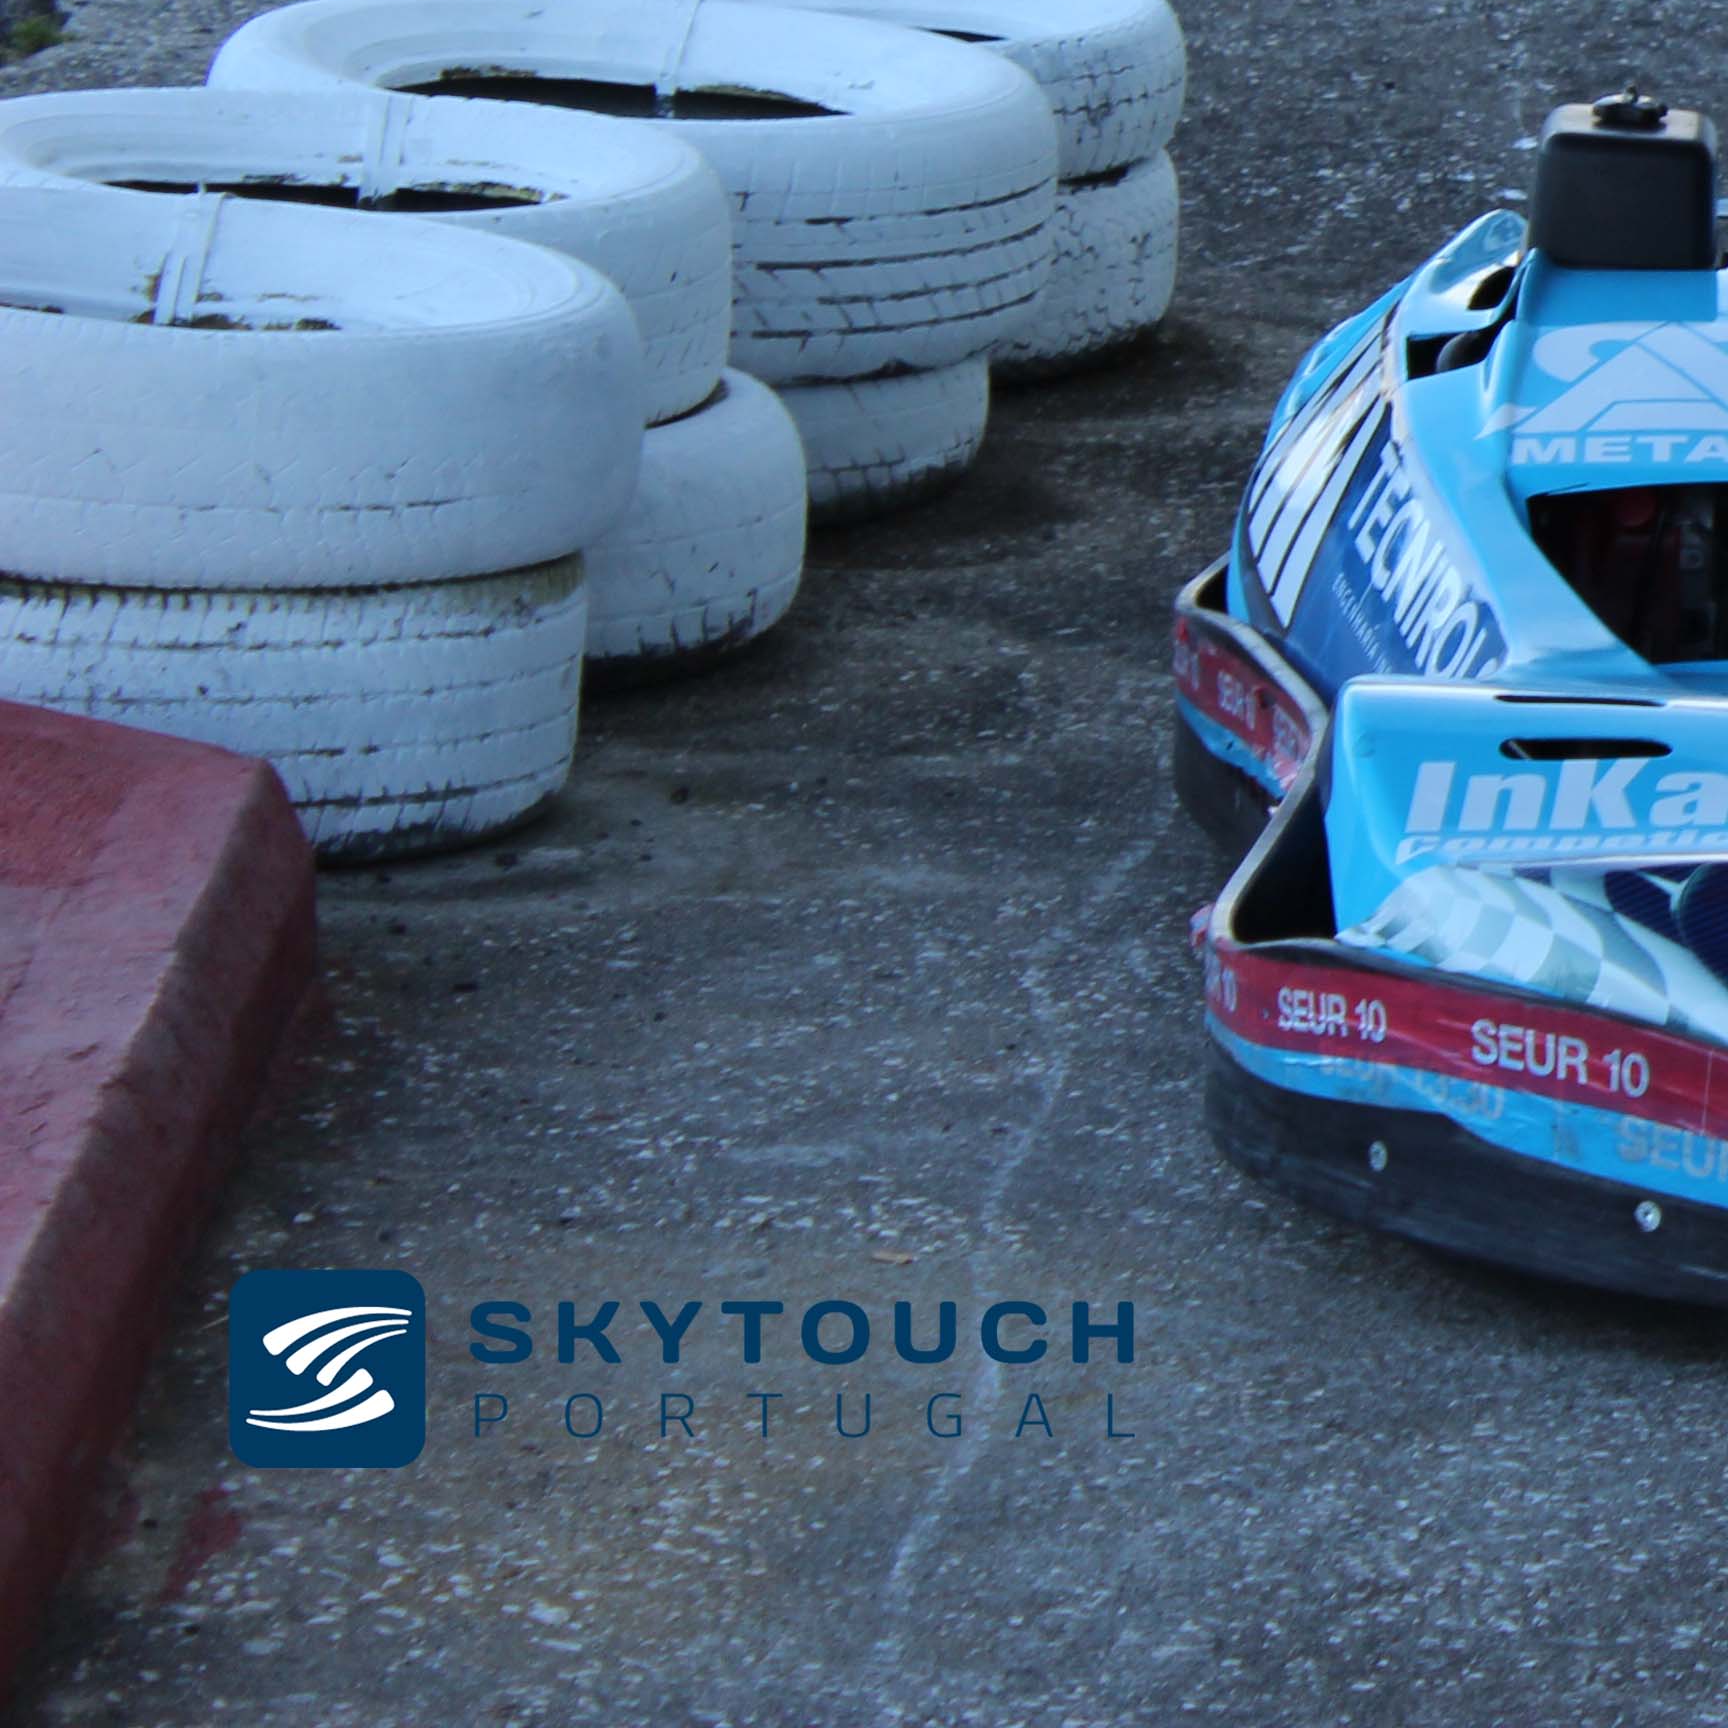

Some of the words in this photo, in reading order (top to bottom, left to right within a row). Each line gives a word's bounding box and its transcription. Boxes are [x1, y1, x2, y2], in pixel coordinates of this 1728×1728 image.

[1277, 986, 1347, 1037] SEUR
[1353, 996, 1387, 1043] 10
[1470, 1018, 1588, 1085] SEUR
[1601, 1048, 1650, 1098] 10
